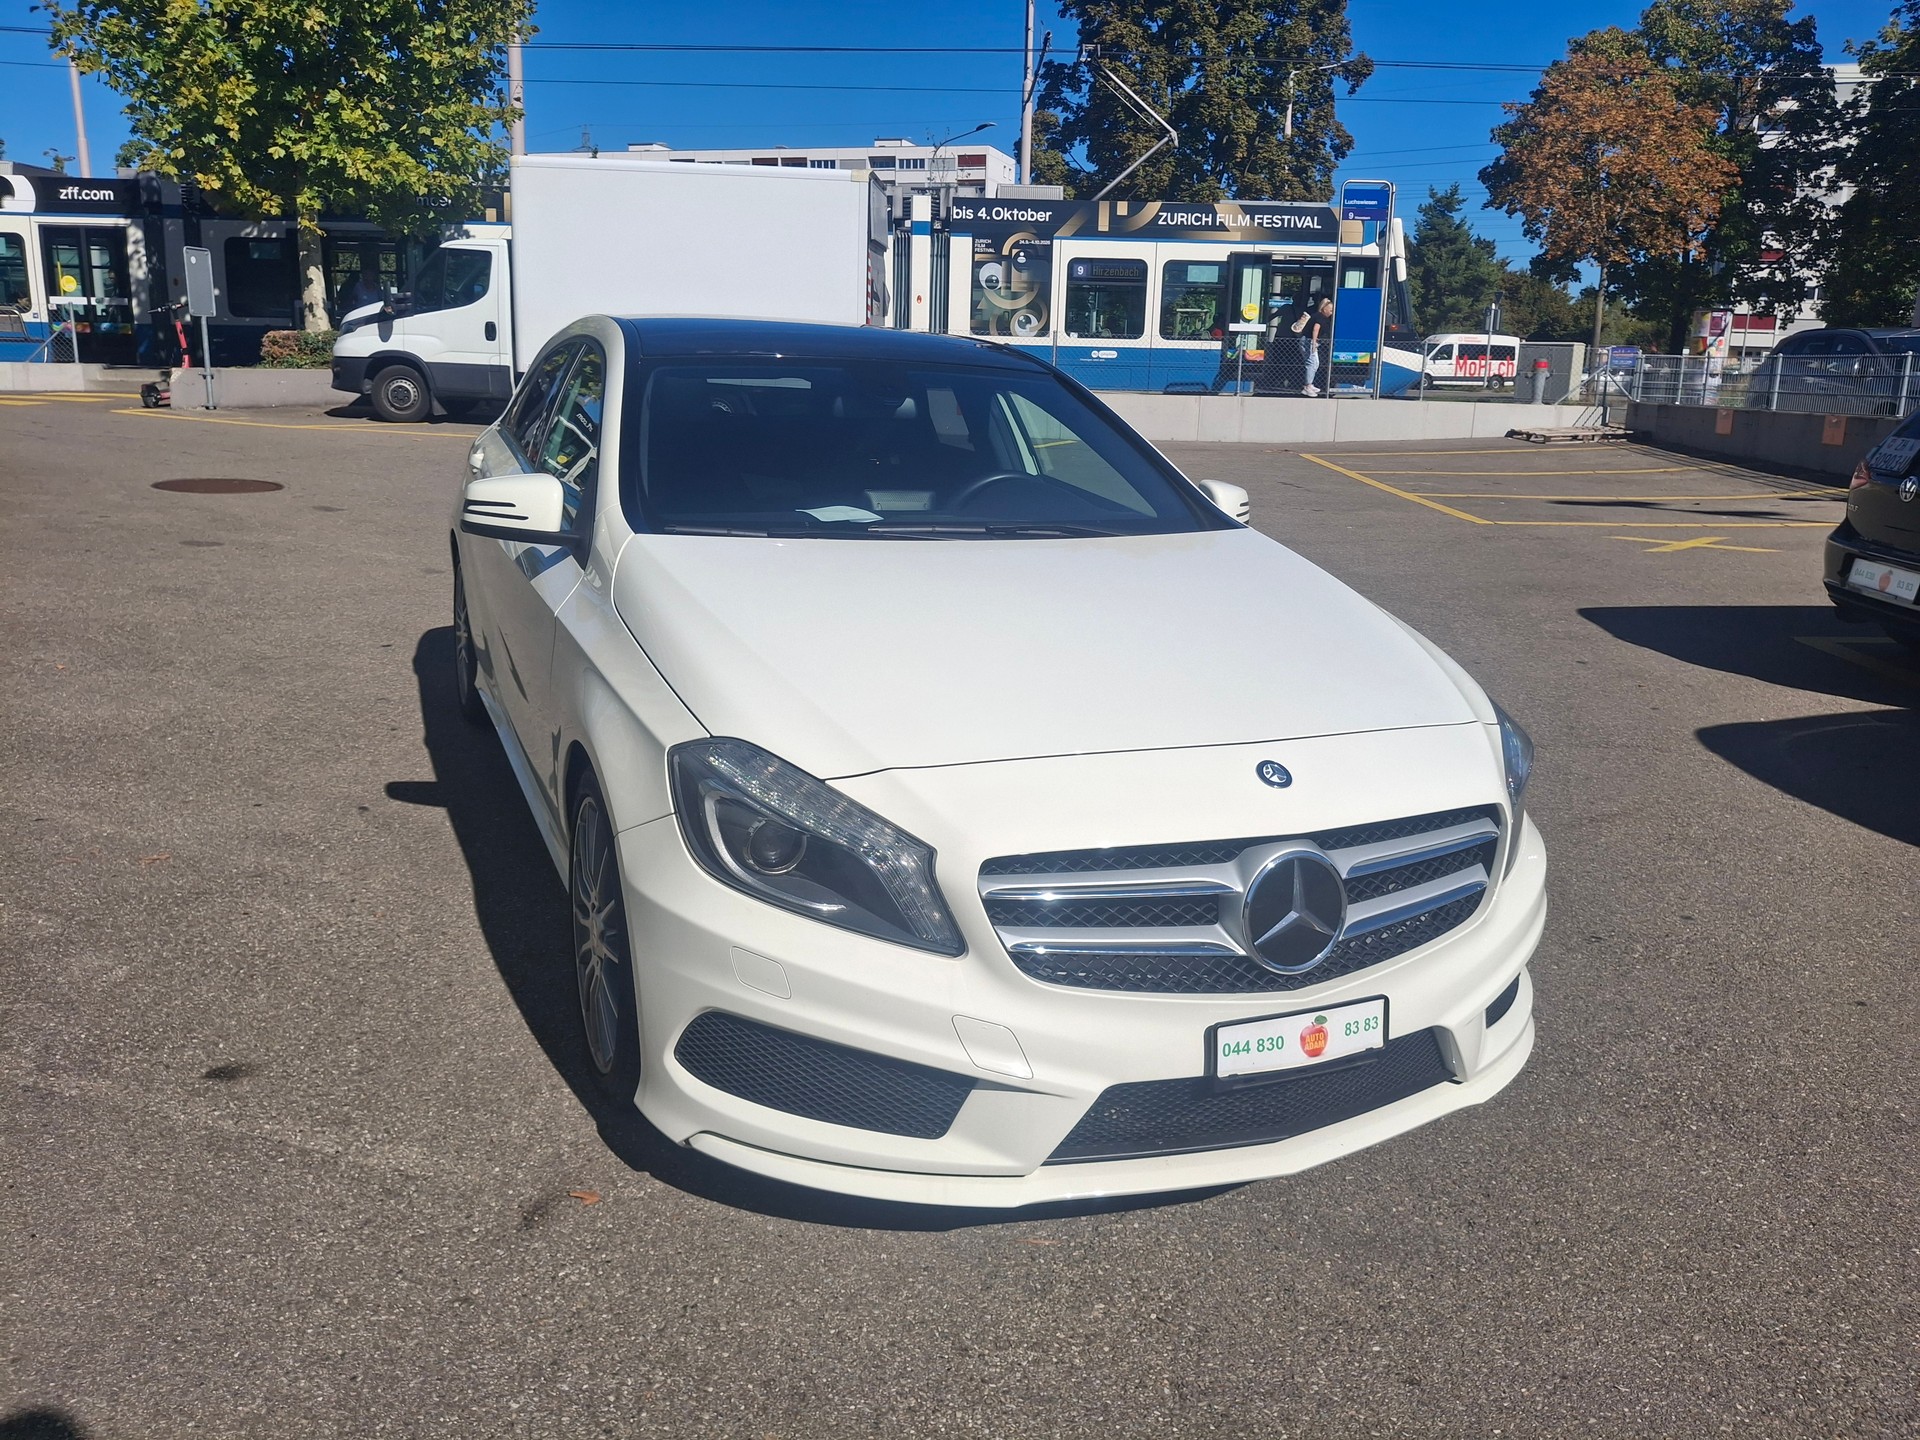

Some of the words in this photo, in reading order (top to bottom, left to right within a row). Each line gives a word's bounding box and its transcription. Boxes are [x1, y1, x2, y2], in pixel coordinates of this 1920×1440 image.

[59, 186, 114, 201] zff.com
[953, 206, 974, 219] bis
[992, 207, 1052, 222] Oktober
[1158, 212, 1212, 226] ZURICH
[1216, 213, 1250, 227] FILM
[1254, 214, 1322, 229] FESTIVAL
[1348, 212, 1354, 220] 9
[1077, 265, 1084, 275] 9
[1092, 265, 1139, 277] Hirzenbach
[1222, 1040, 1250, 1057] 044
[1256, 1036, 1285, 1052] 830
[1344, 1020, 1360, 1036] 83
[1364, 1016, 1379, 1031] 83
[1305, 1032, 1324, 1043] AUTO
[1304, 1041, 1325, 1051] ADAM
